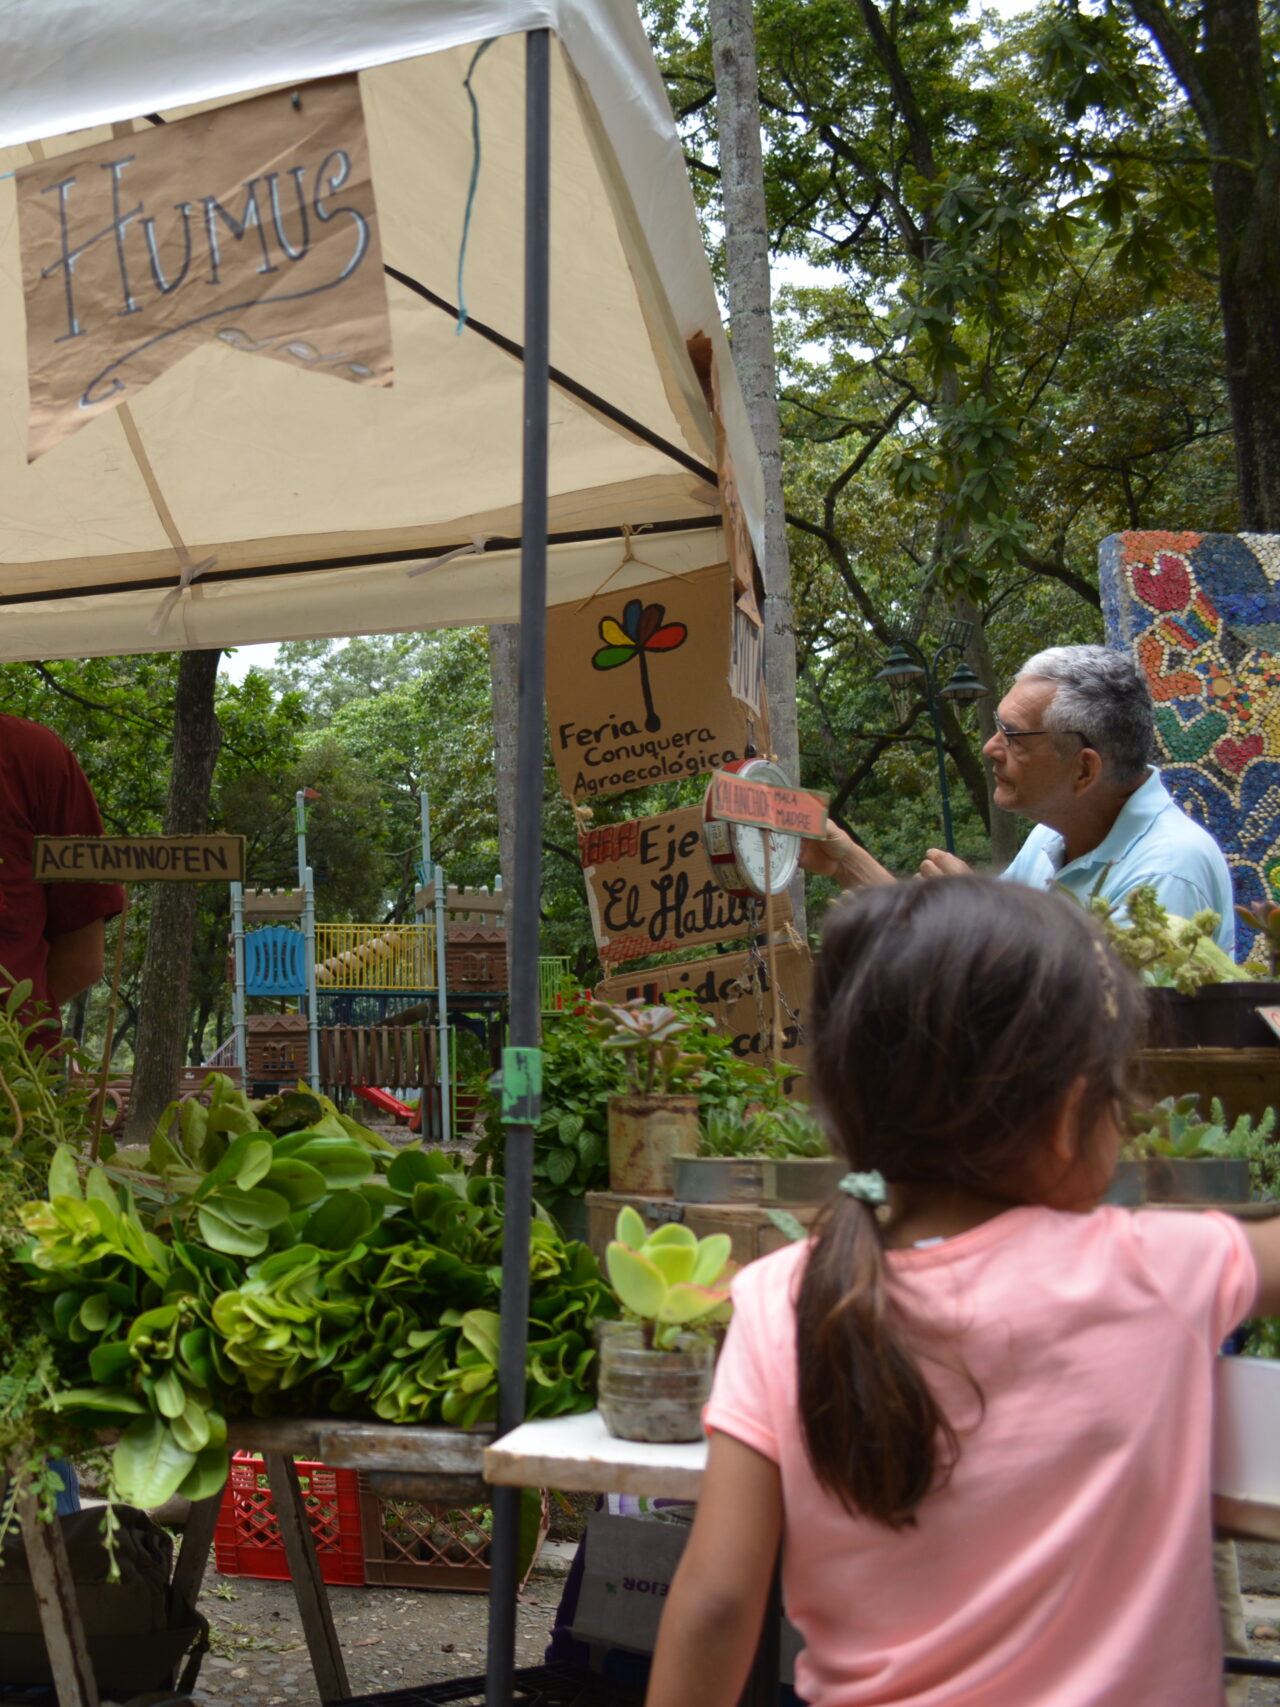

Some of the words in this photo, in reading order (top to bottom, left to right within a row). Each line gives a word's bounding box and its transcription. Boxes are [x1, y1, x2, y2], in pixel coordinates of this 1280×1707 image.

[41, 150, 370, 343] HUMUS
[560, 714, 641, 749] Feria
[584, 728, 716, 766] Conuquera
[573, 750, 739, 795] Agroecológica
[774, 791, 797, 805] MALA
[776, 809, 812, 830] MADRE
[41, 843, 227, 873] ACETAMINOFEN
[641, 825, 699, 871] Eje
[602, 878, 645, 931] El
[627, 966, 769, 1004] Udad
[623, 1577, 670, 1596] EJOR
